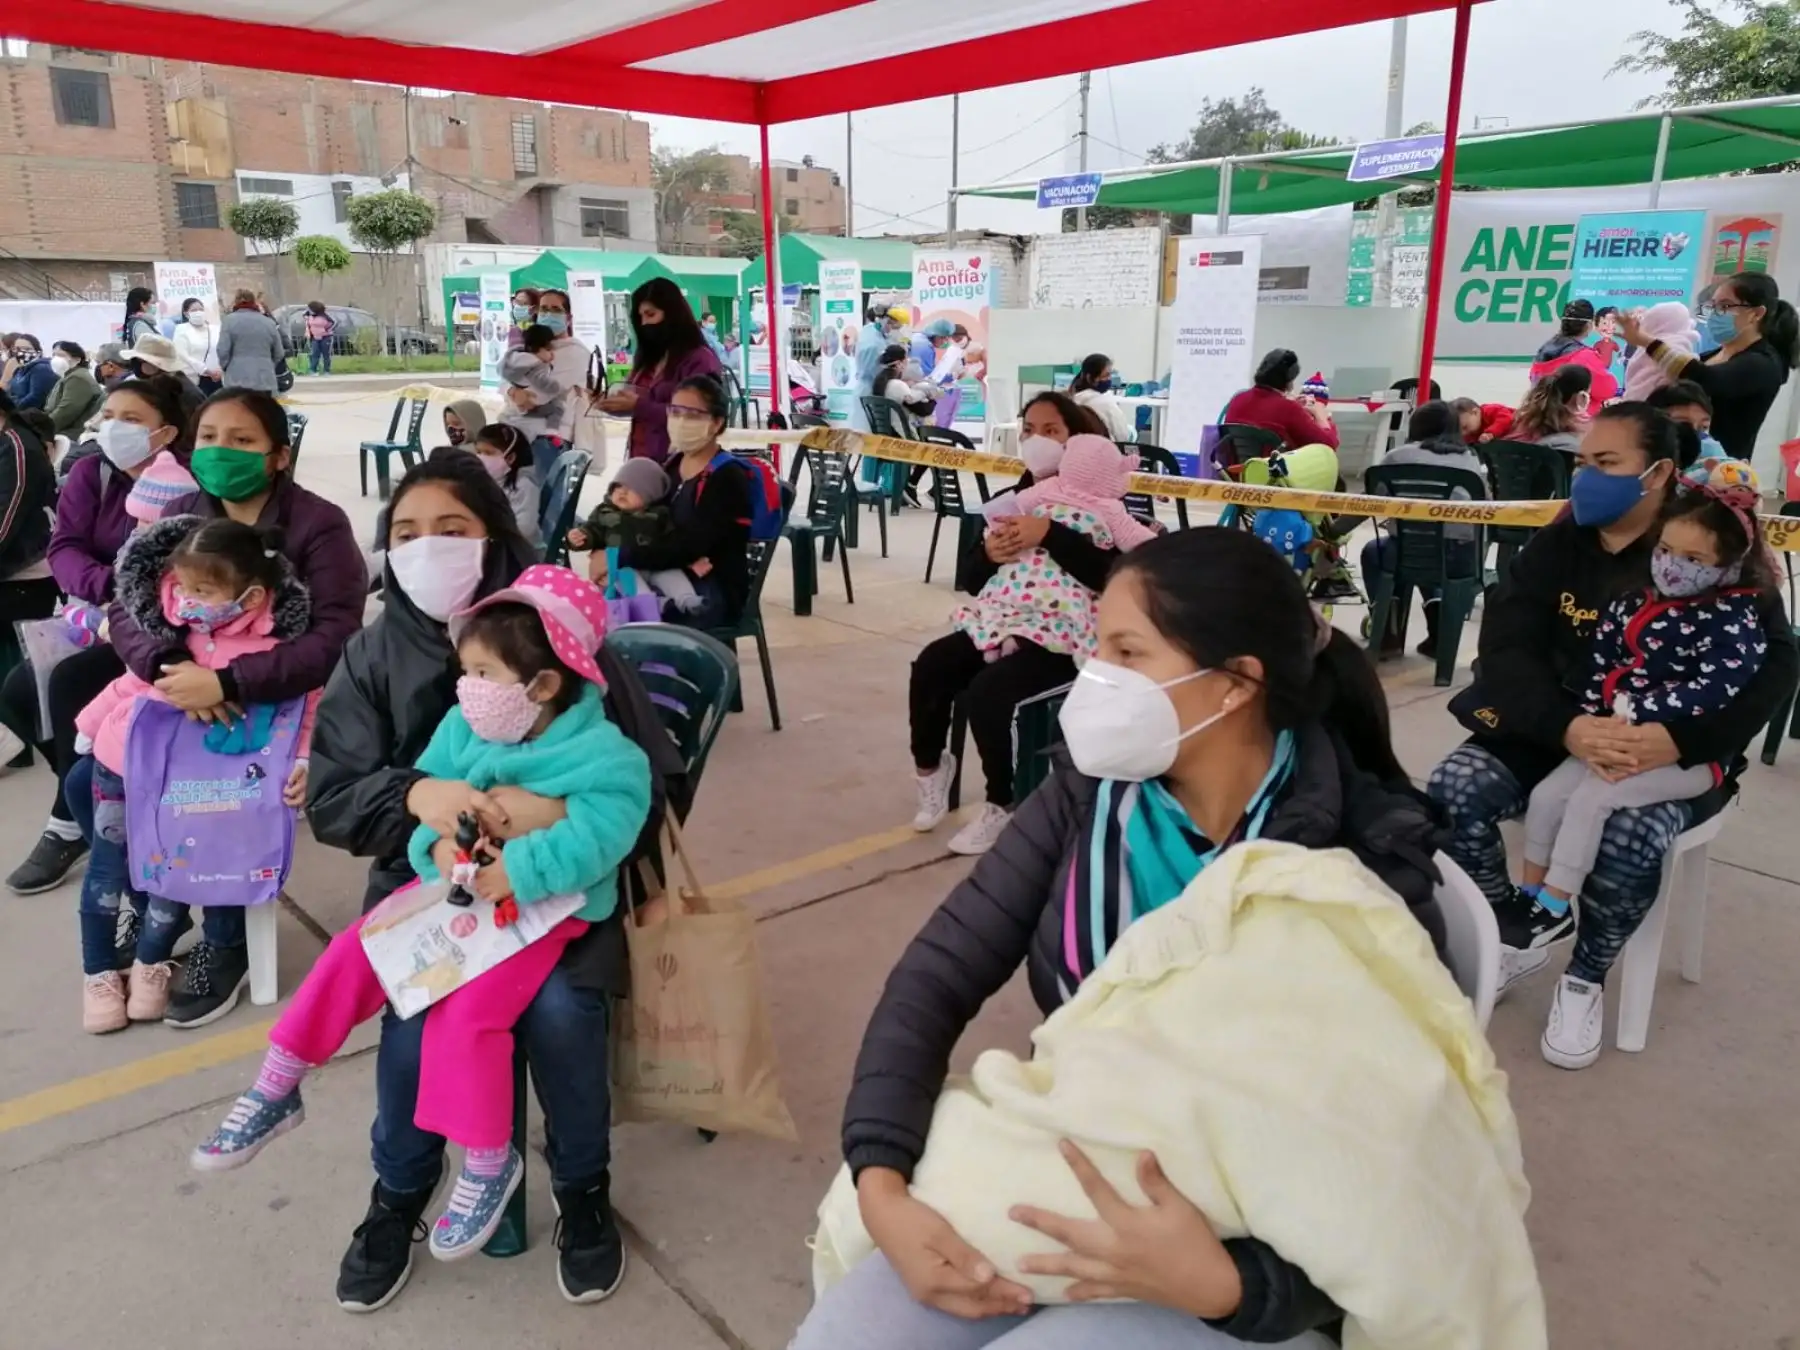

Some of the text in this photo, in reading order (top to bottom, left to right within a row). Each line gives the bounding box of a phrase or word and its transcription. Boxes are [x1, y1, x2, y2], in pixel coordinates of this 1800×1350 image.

[1044, 182, 1097, 198] VACUNACIÓN
[1460, 223, 1575, 272] ANE
[919, 282, 986, 304] protege
[1221, 489, 1275, 505] OBRAS
[1428, 504, 1498, 521] OBRAS
